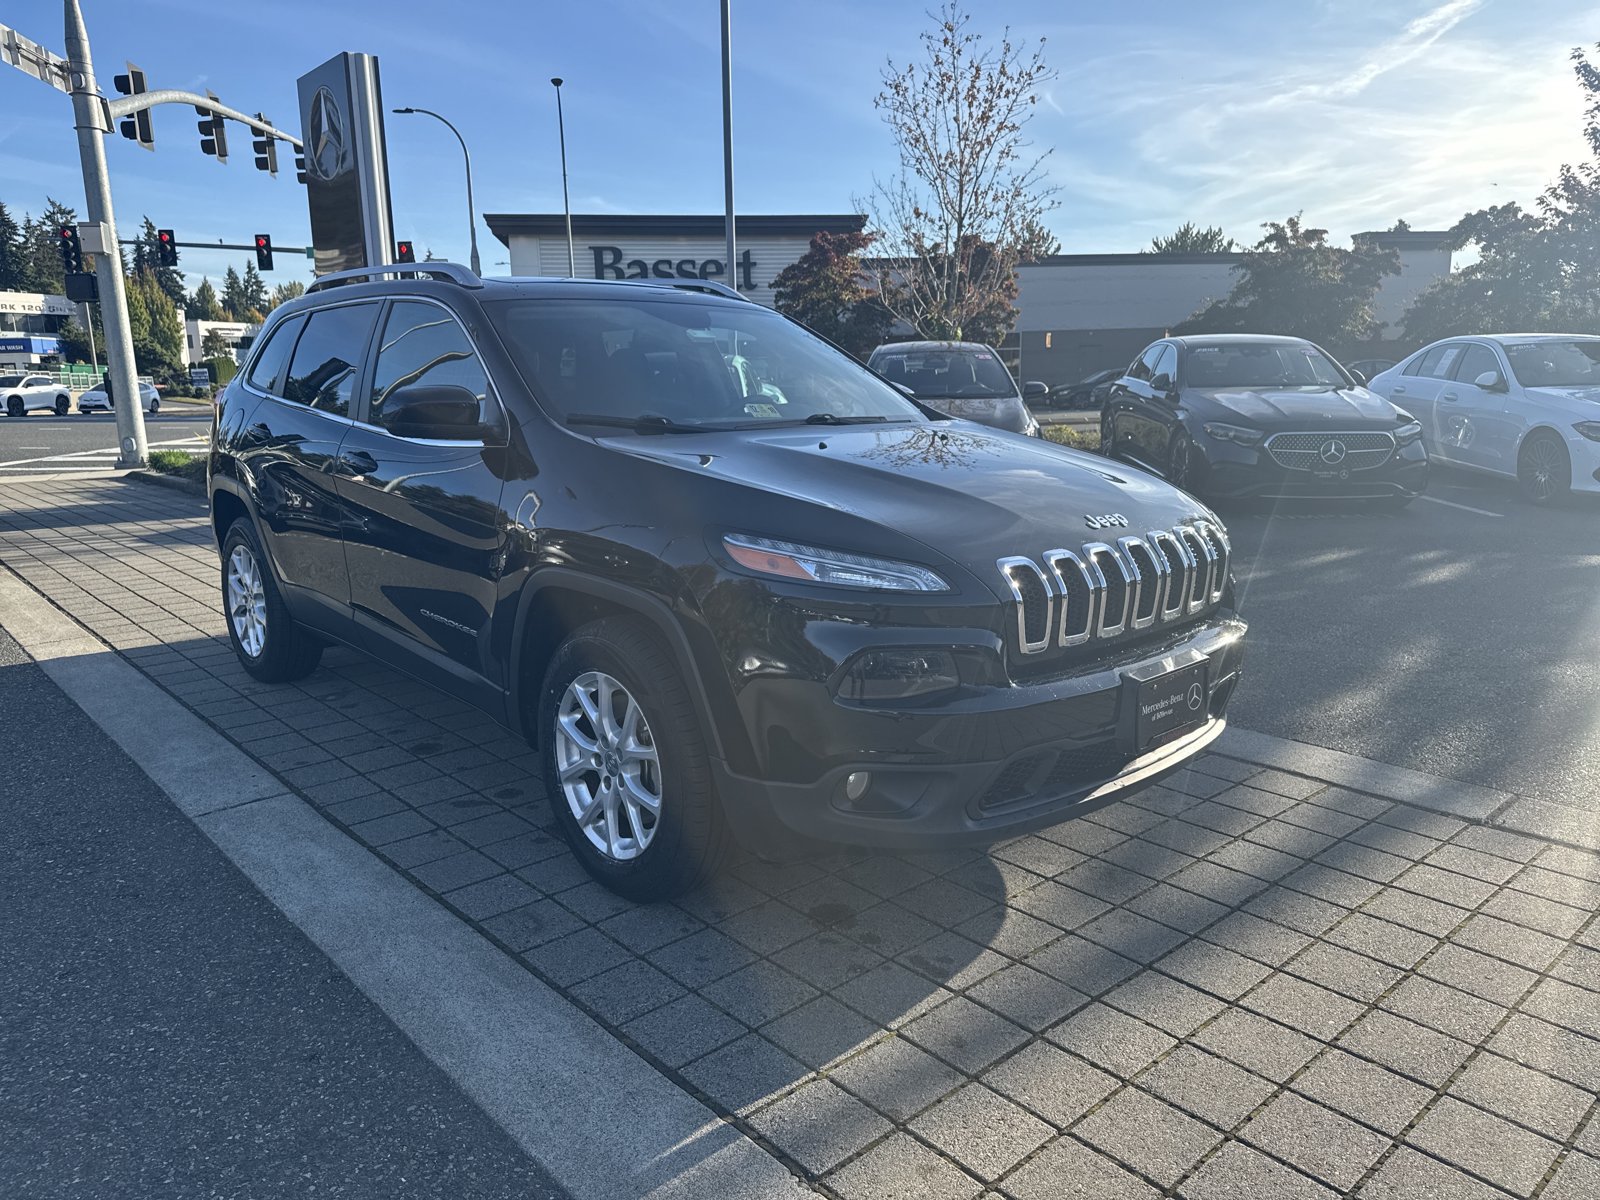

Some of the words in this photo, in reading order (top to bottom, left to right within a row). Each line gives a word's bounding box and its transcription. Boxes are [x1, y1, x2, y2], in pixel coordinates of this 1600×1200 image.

[588, 246, 758, 291] Basset
[1083, 513, 1129, 530] Jeep
[1141, 693, 1184, 716] Mercedes-Benz
